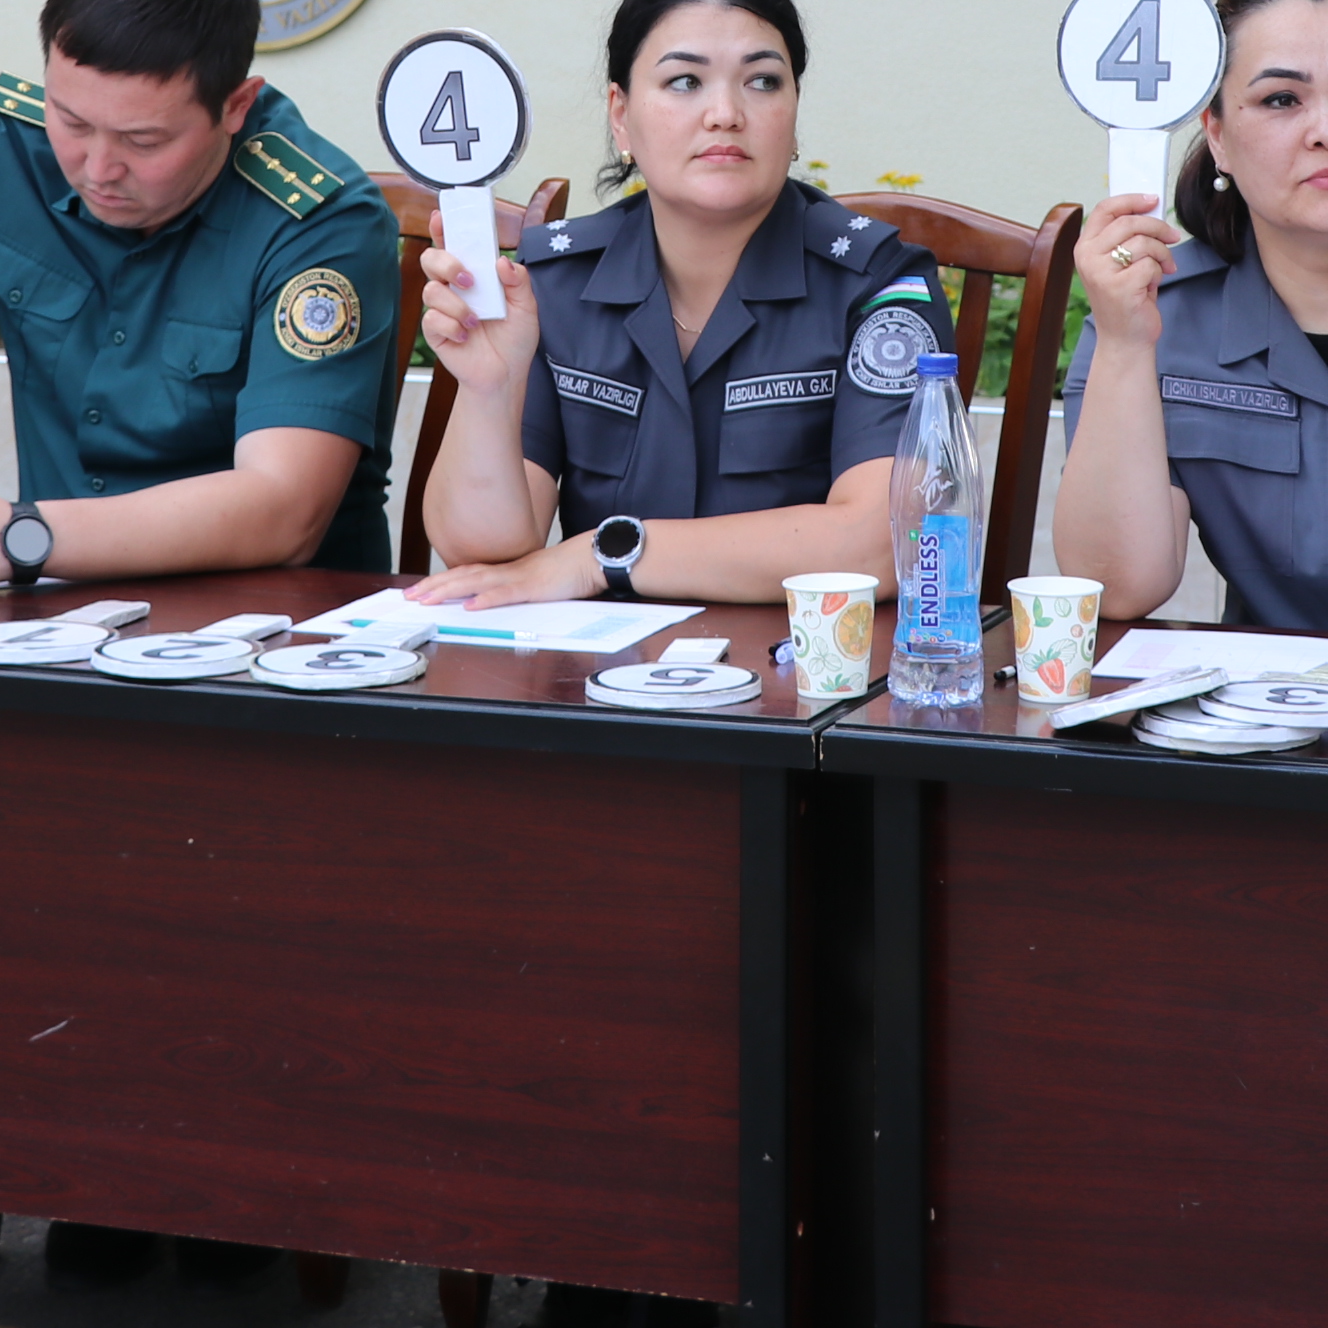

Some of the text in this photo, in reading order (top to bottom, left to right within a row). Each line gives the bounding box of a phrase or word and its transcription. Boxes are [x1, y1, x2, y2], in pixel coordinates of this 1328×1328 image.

[419, 70, 480, 162] 4
[558, 374, 589, 394] ISHLAR
[592, 381, 637, 408] VAZIRLIGI
[728, 377, 832, 404] ABDULLAYEVA G.K.
[1169, 381, 1290, 411] ICHKI ISHLAR VAZIRLIGI
[919, 534, 939, 628] ENDLESS
[141, 639, 232, 659] 2
[304, 649, 387, 669] 3
[644, 667, 715, 686] 5
